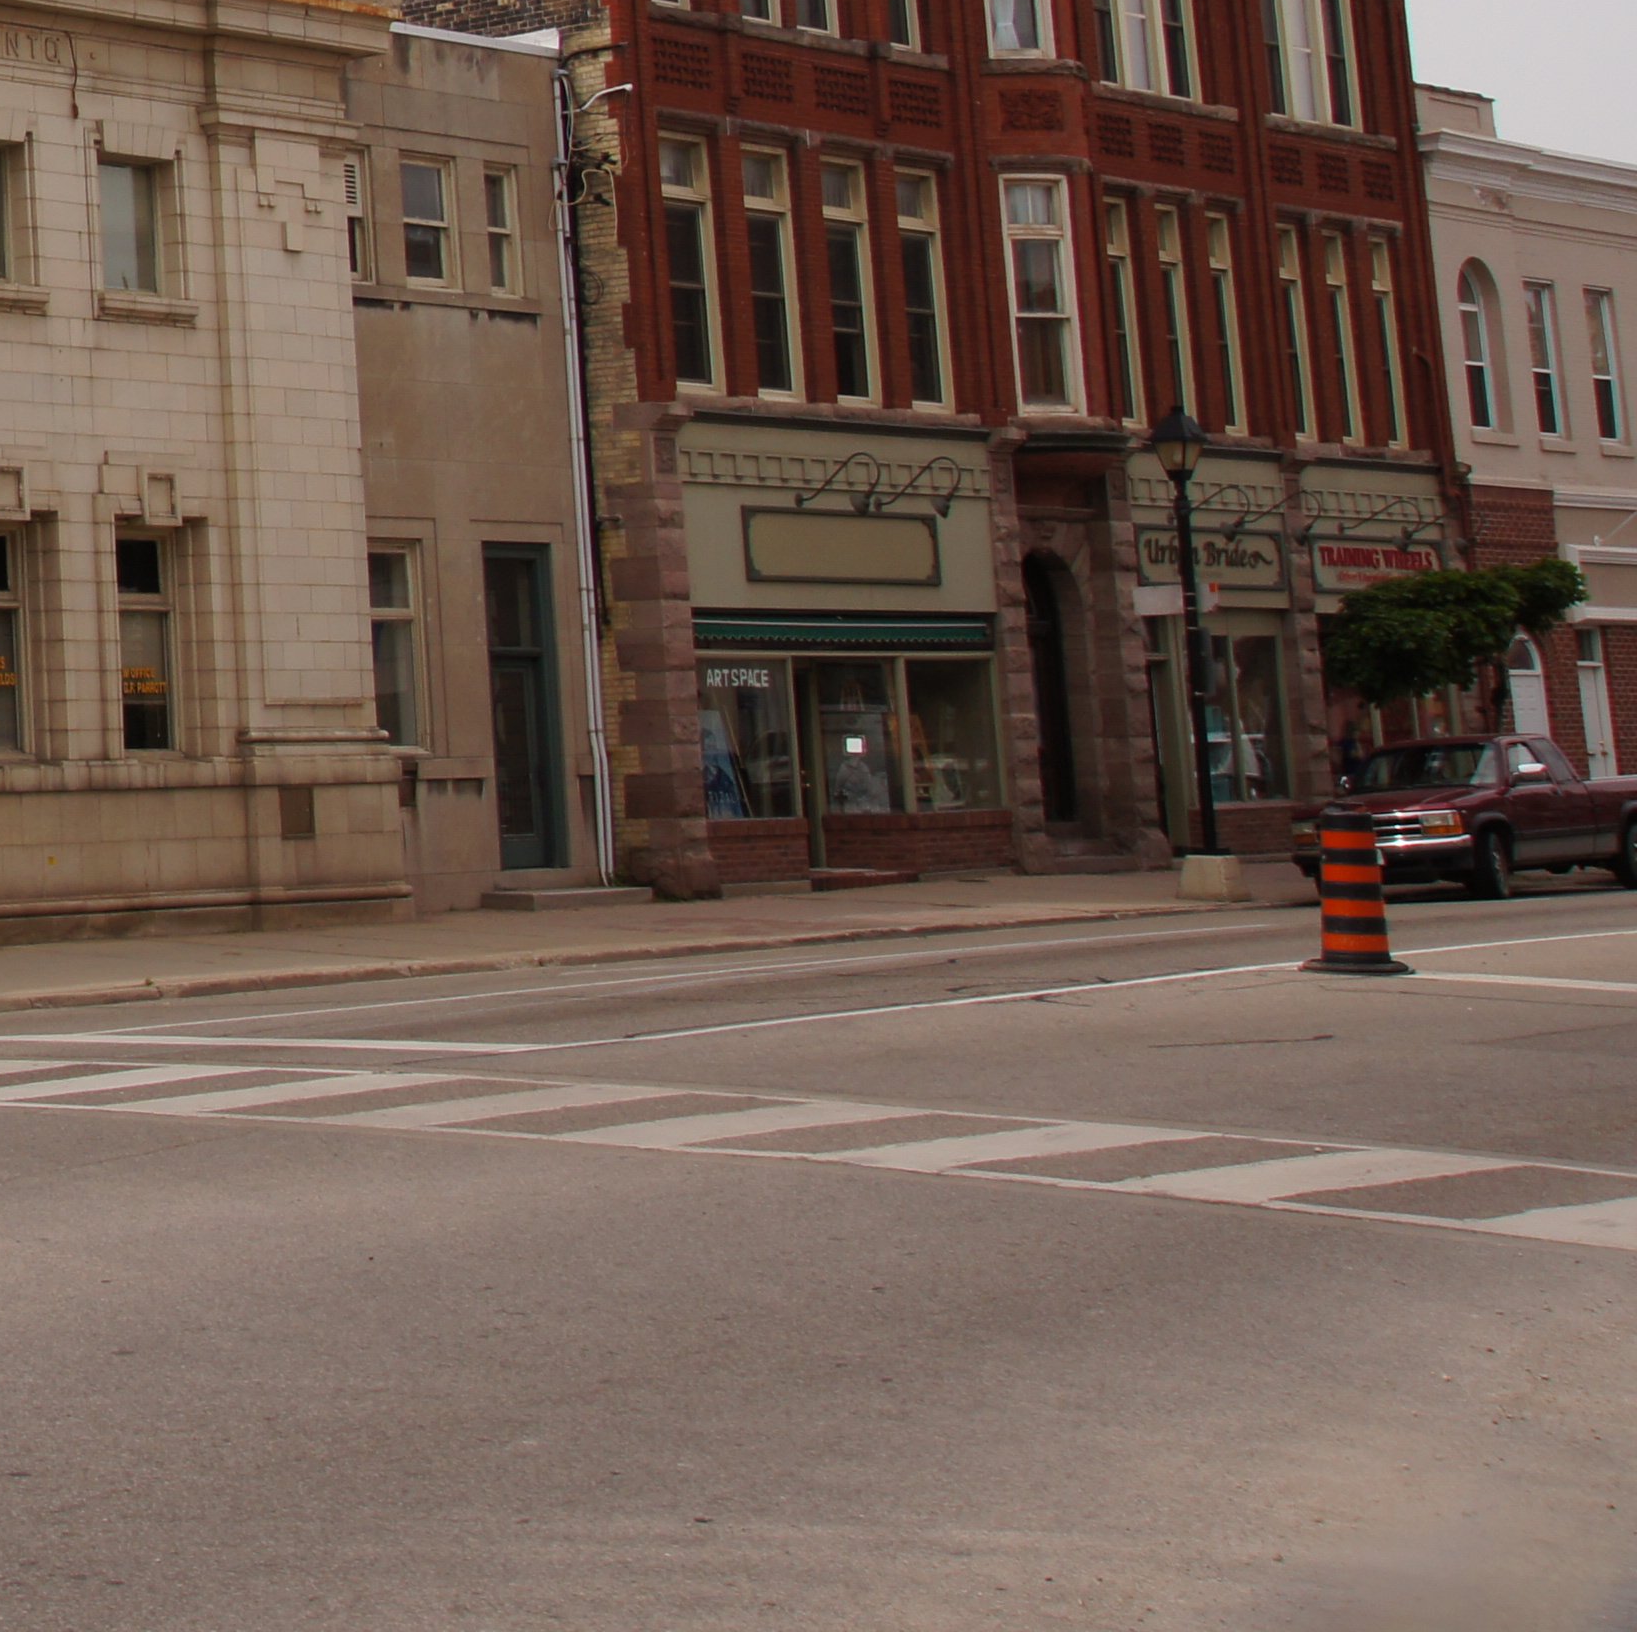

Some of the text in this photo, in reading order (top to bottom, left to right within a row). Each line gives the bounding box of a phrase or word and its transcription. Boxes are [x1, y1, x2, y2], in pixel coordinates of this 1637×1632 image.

[1144, 534, 1200, 565] Urbn
[1318, 545, 1434, 571] TRAINING WHEELS
[706, 668, 770, 688] ARTSPACE
